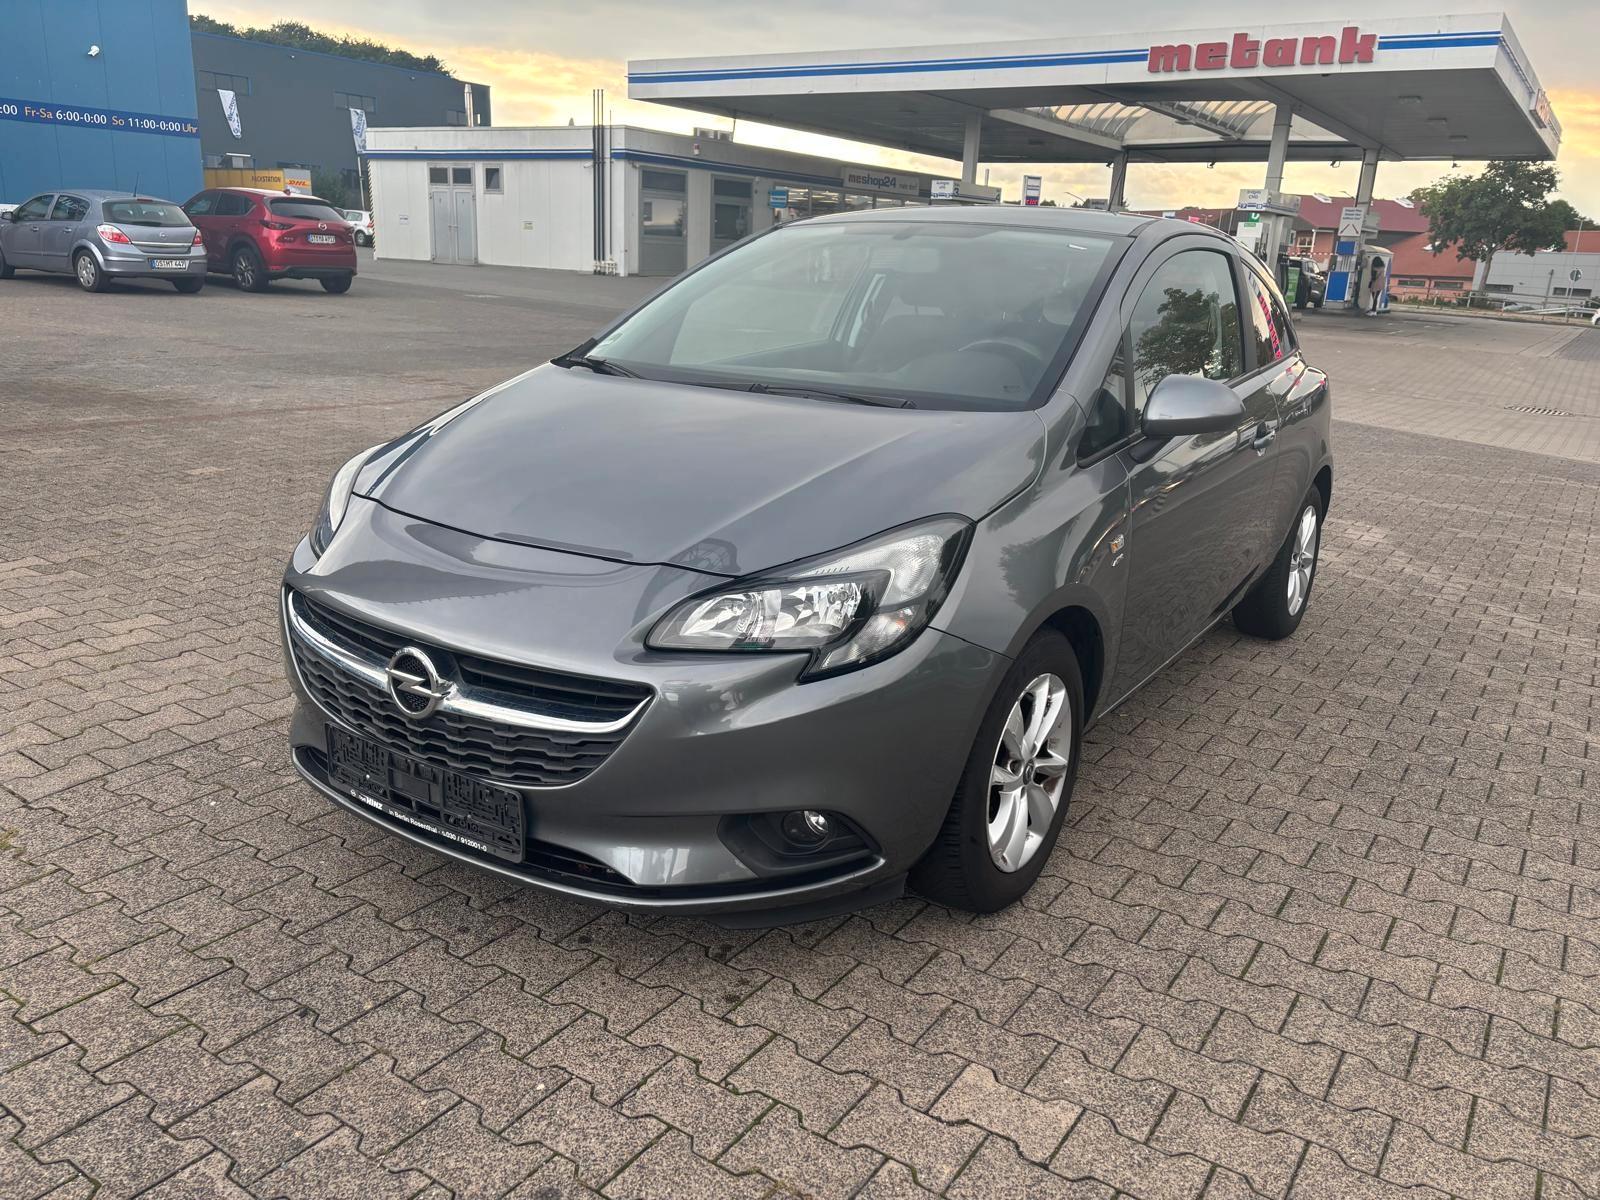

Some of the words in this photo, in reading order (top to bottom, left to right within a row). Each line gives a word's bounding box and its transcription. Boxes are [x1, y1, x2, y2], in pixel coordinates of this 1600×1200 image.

[1148, 27, 1377, 73] metank
[24, 106, 53, 119] Fr-Sa
[56, 110, 107, 124] 6:00-0:00
[112, 115, 125, 126] So
[128, 118, 181, 132] 11:00-0:00
[182, 123, 198, 133] Uhr
[288, 179, 308, 187] DHL
[848, 173, 897, 188] meshop24
[394, 811, 410, 823] Berlin
[410, 818, 438, 834] Rosenthal
